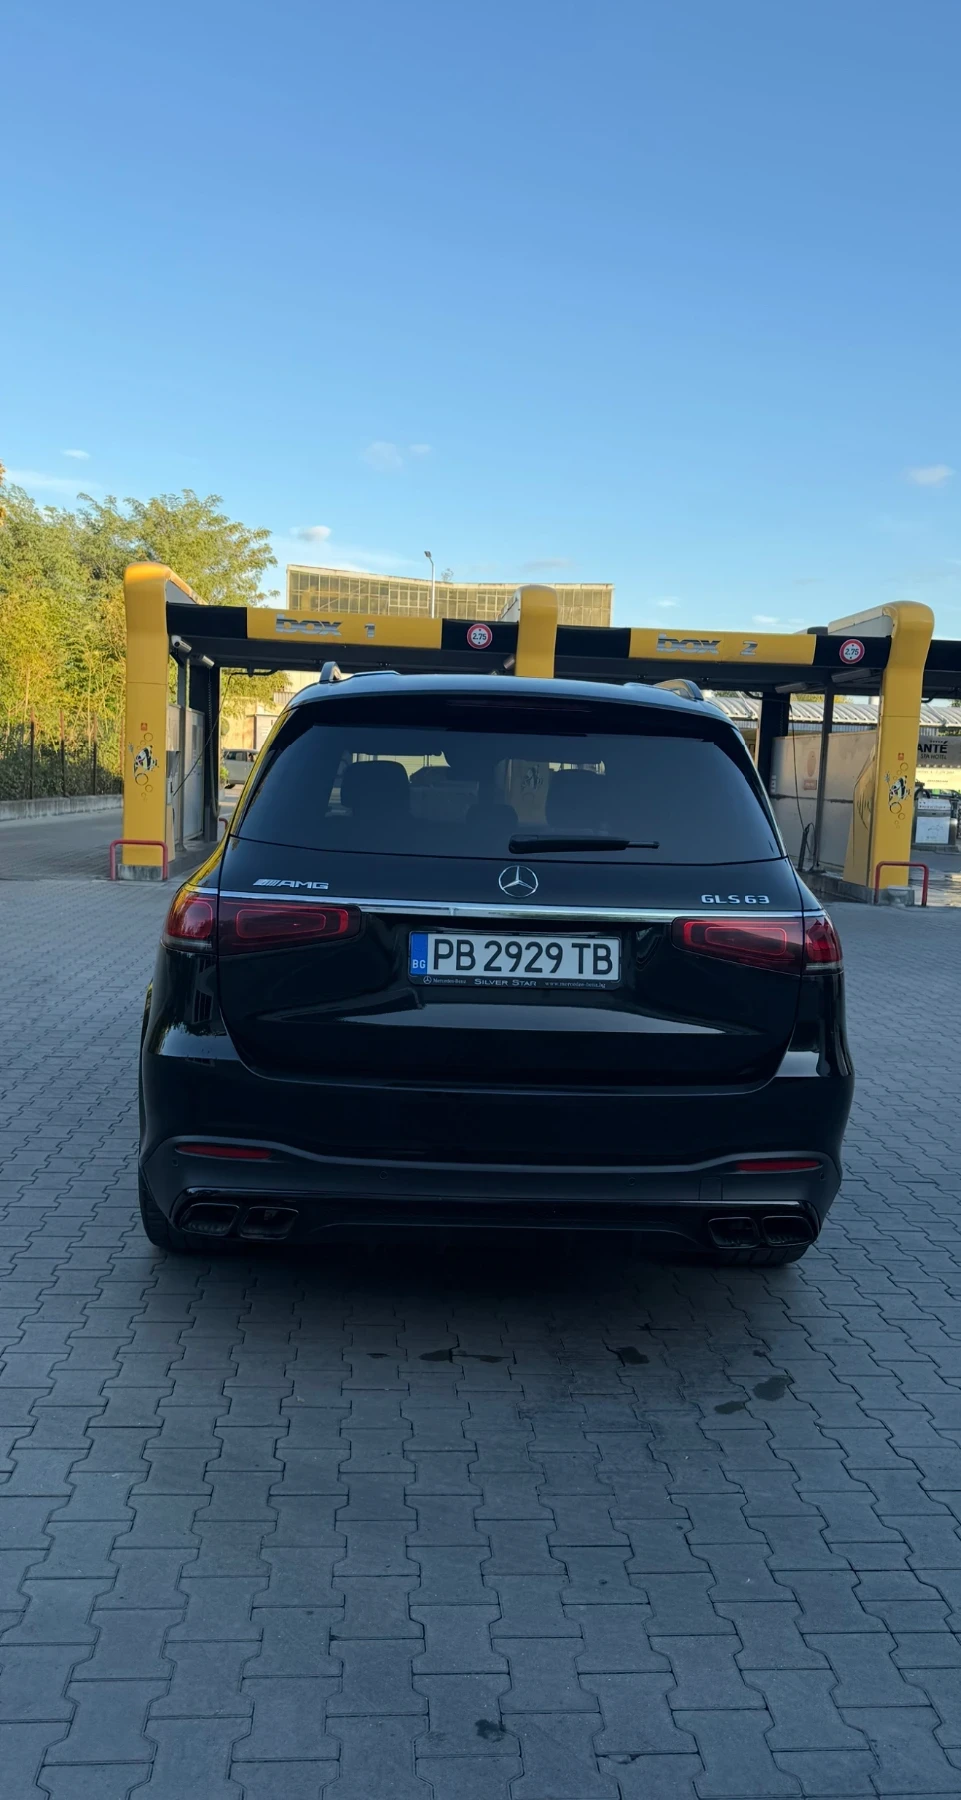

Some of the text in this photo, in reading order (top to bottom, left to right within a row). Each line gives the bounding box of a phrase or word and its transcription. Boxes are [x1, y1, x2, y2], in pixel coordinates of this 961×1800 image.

[275, 613, 376, 639] box 1
[472, 632, 487, 640] 2.75
[656, 633, 758, 656] box 2
[845, 648, 859, 656] 2.75
[277, 879, 329, 890] AMG
[701, 894, 770, 904] GLS 63
[433, 938, 613, 975] PB 2929 TB
[412, 959, 426, 969] BG
